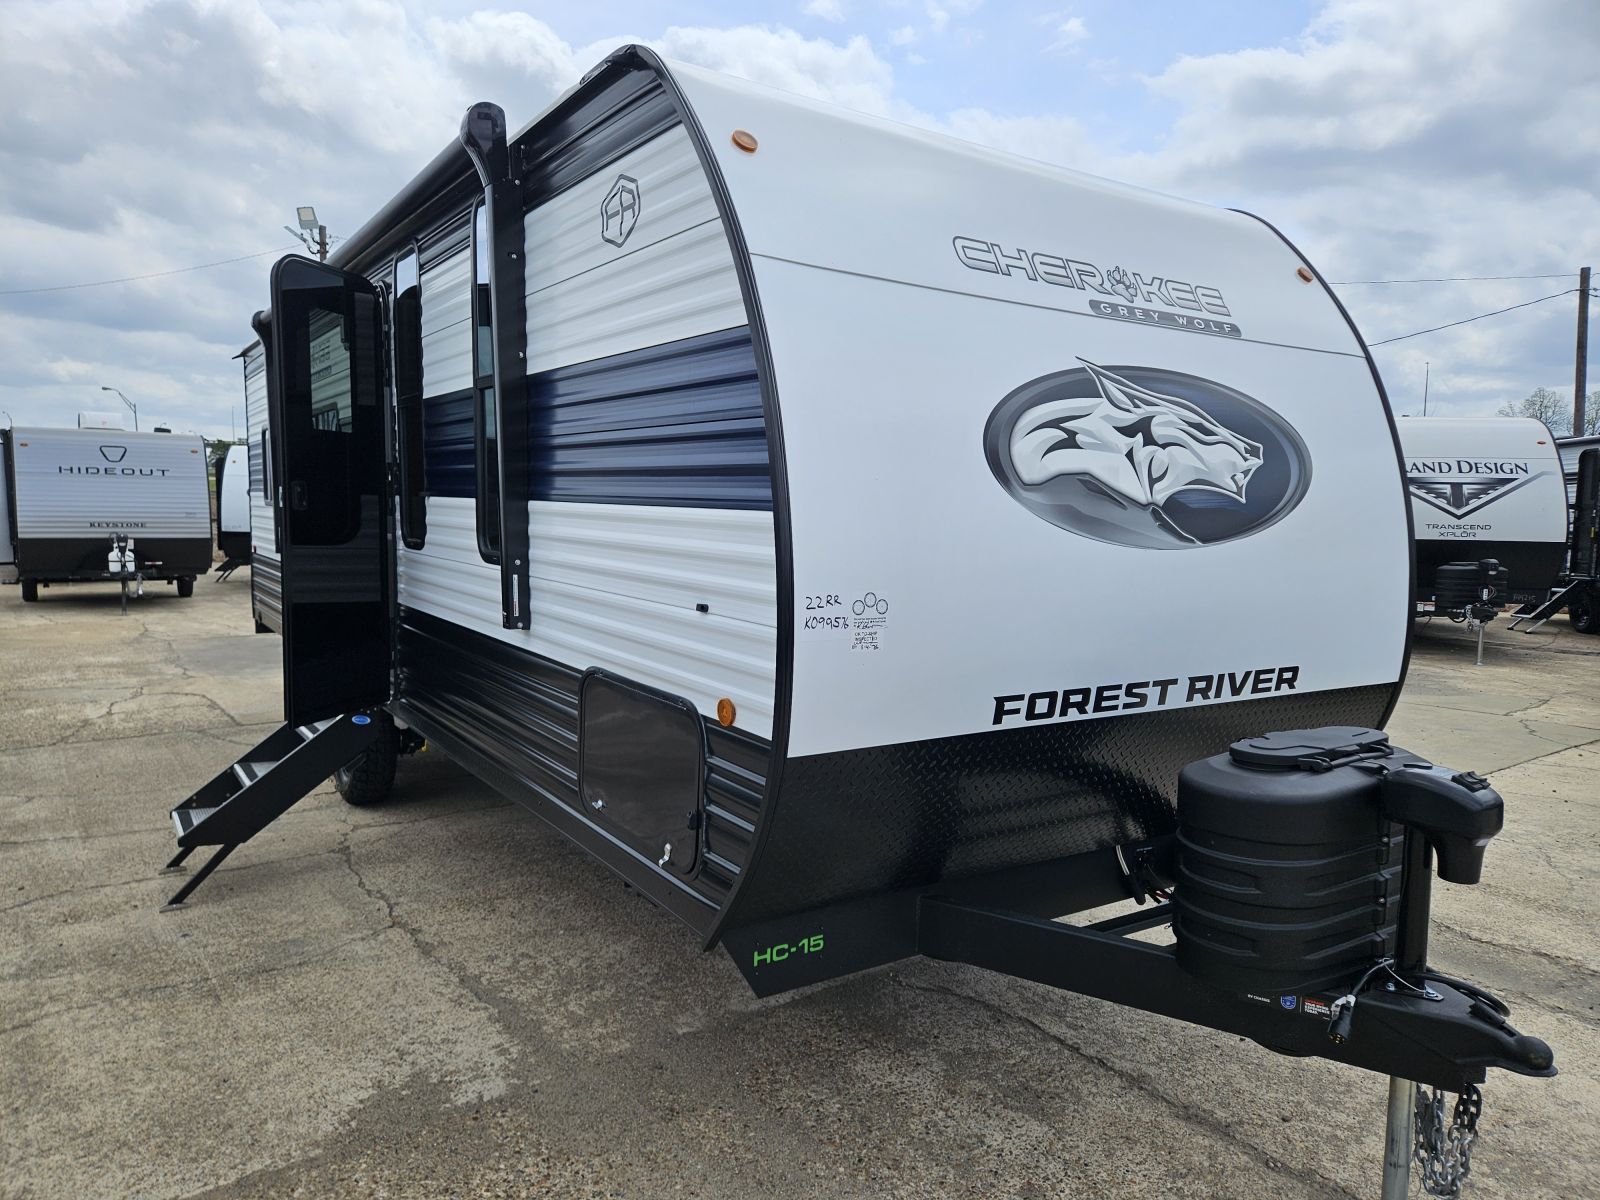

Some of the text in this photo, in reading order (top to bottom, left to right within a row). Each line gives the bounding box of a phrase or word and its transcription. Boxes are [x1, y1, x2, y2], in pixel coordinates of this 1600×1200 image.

[1099, 302, 1233, 334] GREY WOLF
[58, 466, 170, 477] HIDEOUT
[1406, 460, 1529, 475] AND DESIGN
[1425, 523, 1492, 531] TRANSCEND
[805, 594, 842, 610] 22RR
[992, 666, 1300, 726] FOREST RIVER
[753, 934, 824, 967] HC-15
